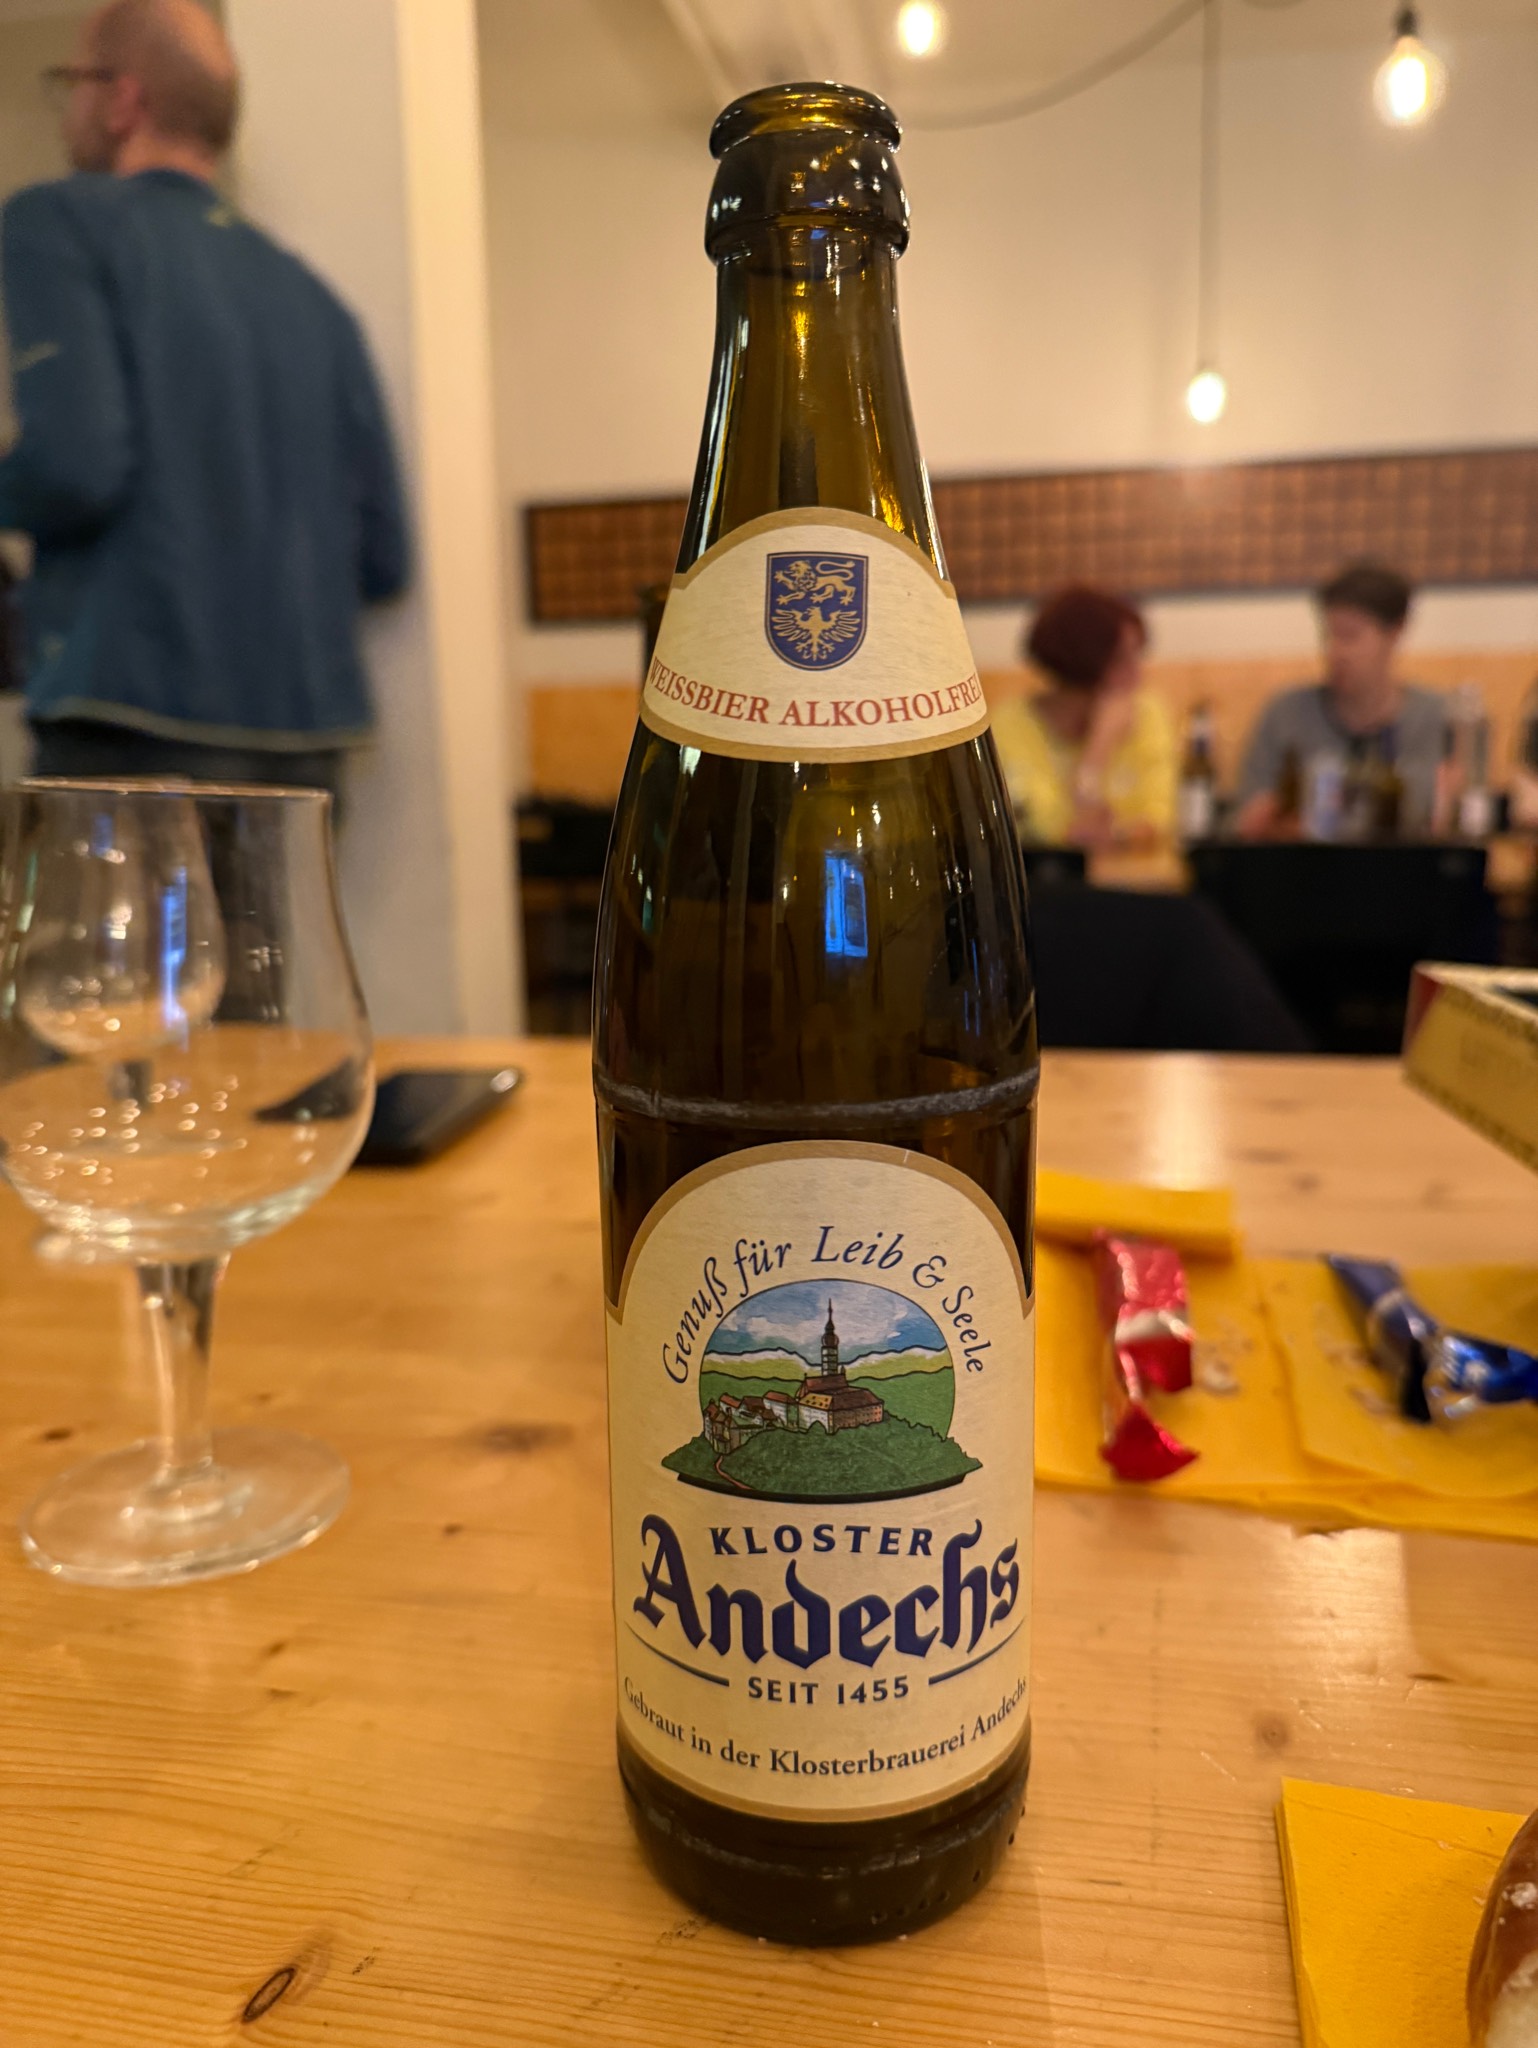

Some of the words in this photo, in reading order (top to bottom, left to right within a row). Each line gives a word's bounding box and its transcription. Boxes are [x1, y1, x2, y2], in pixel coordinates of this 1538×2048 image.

[649, 656, 769, 724] WEISSBIER
[779, 672, 981, 726] ALKOHOLFREI
[661, 1256, 729, 1384] Genuß
[733, 1237, 793, 1298] für
[811, 1225, 905, 1270] Leib
[912, 1255, 948, 1289] &
[942, 1284, 995, 1374] Seele
[709, 1523, 933, 1557] KLOSTER
[633, 1513, 1020, 1670] Andechs
[624, 1675, 685, 1742] Gebraut
[690, 1726, 712, 1755] in
[720, 1738, 761, 1769] der
[769, 1724, 966, 1776] Klosterbrauerei
[970, 1676, 1028, 1742] Andechs
[748, 1675, 819, 1704] SEIT
[837, 1674, 910, 1705] 1455
